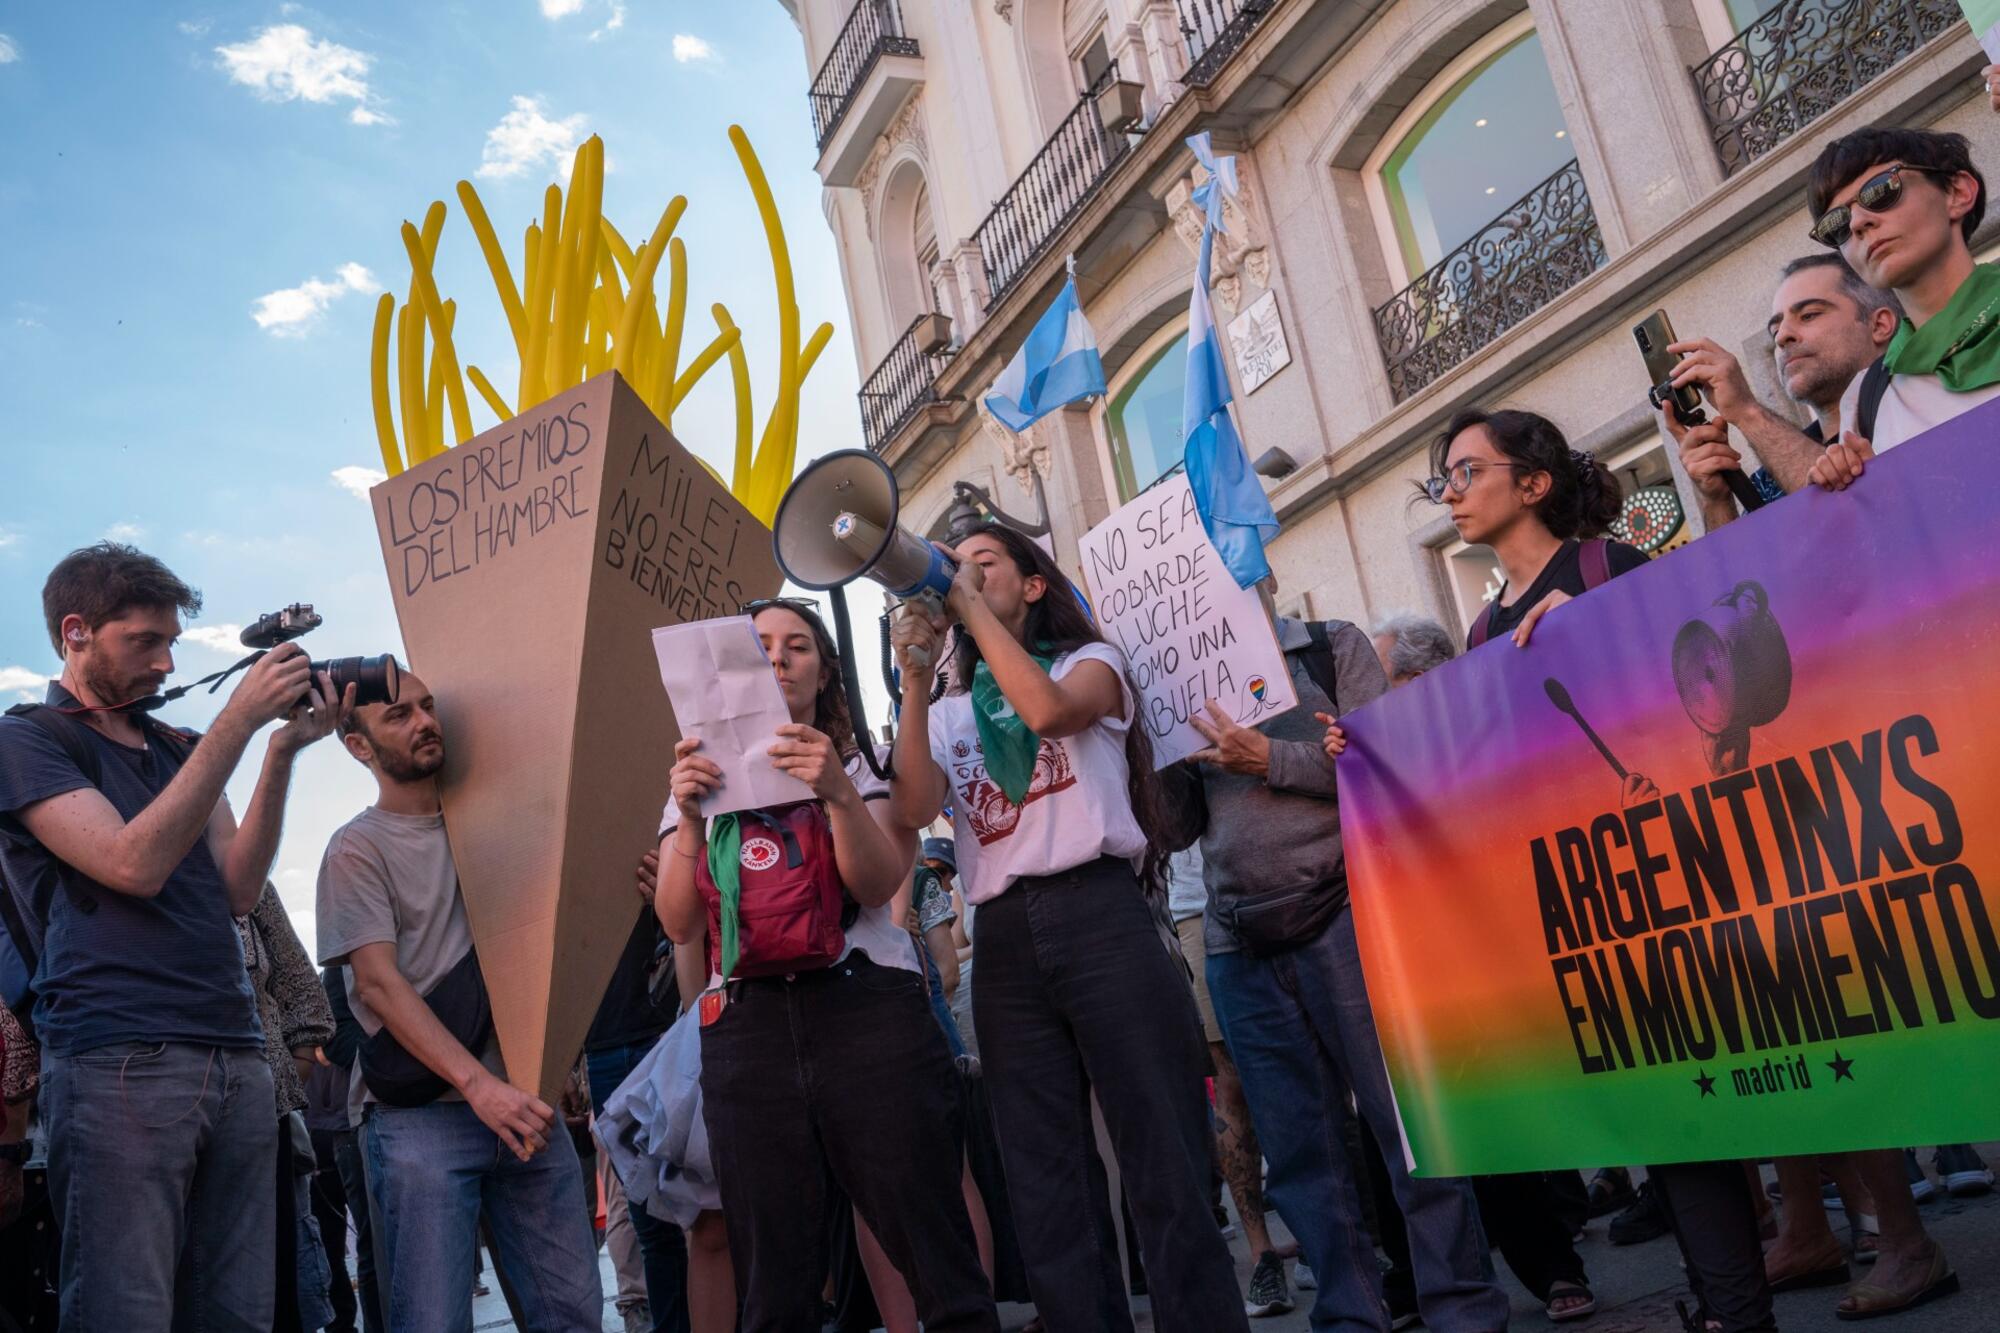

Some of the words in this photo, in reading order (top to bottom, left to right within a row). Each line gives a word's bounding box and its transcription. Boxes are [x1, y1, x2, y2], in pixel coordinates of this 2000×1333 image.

[387, 468, 460, 547] LOS
[403, 529, 471, 597] DEL
[475, 465, 590, 566] HAMBRE
[610, 488, 659, 552] NO
[664, 531, 742, 616] ERES
[1090, 528, 1127, 591] NO
[1137, 488, 1199, 550] SEA
[1100, 543, 1207, 624] COBARDE
[1116, 578, 1212, 661] LUCHE
[1189, 617, 1237, 661] UNA
[1530, 714, 1964, 955] ARGENTINXS
[1551, 951, 1637, 1074] EN
[1615, 862, 2000, 1067] MOVIMIENTO
[1730, 1053, 1813, 1097] madrid
